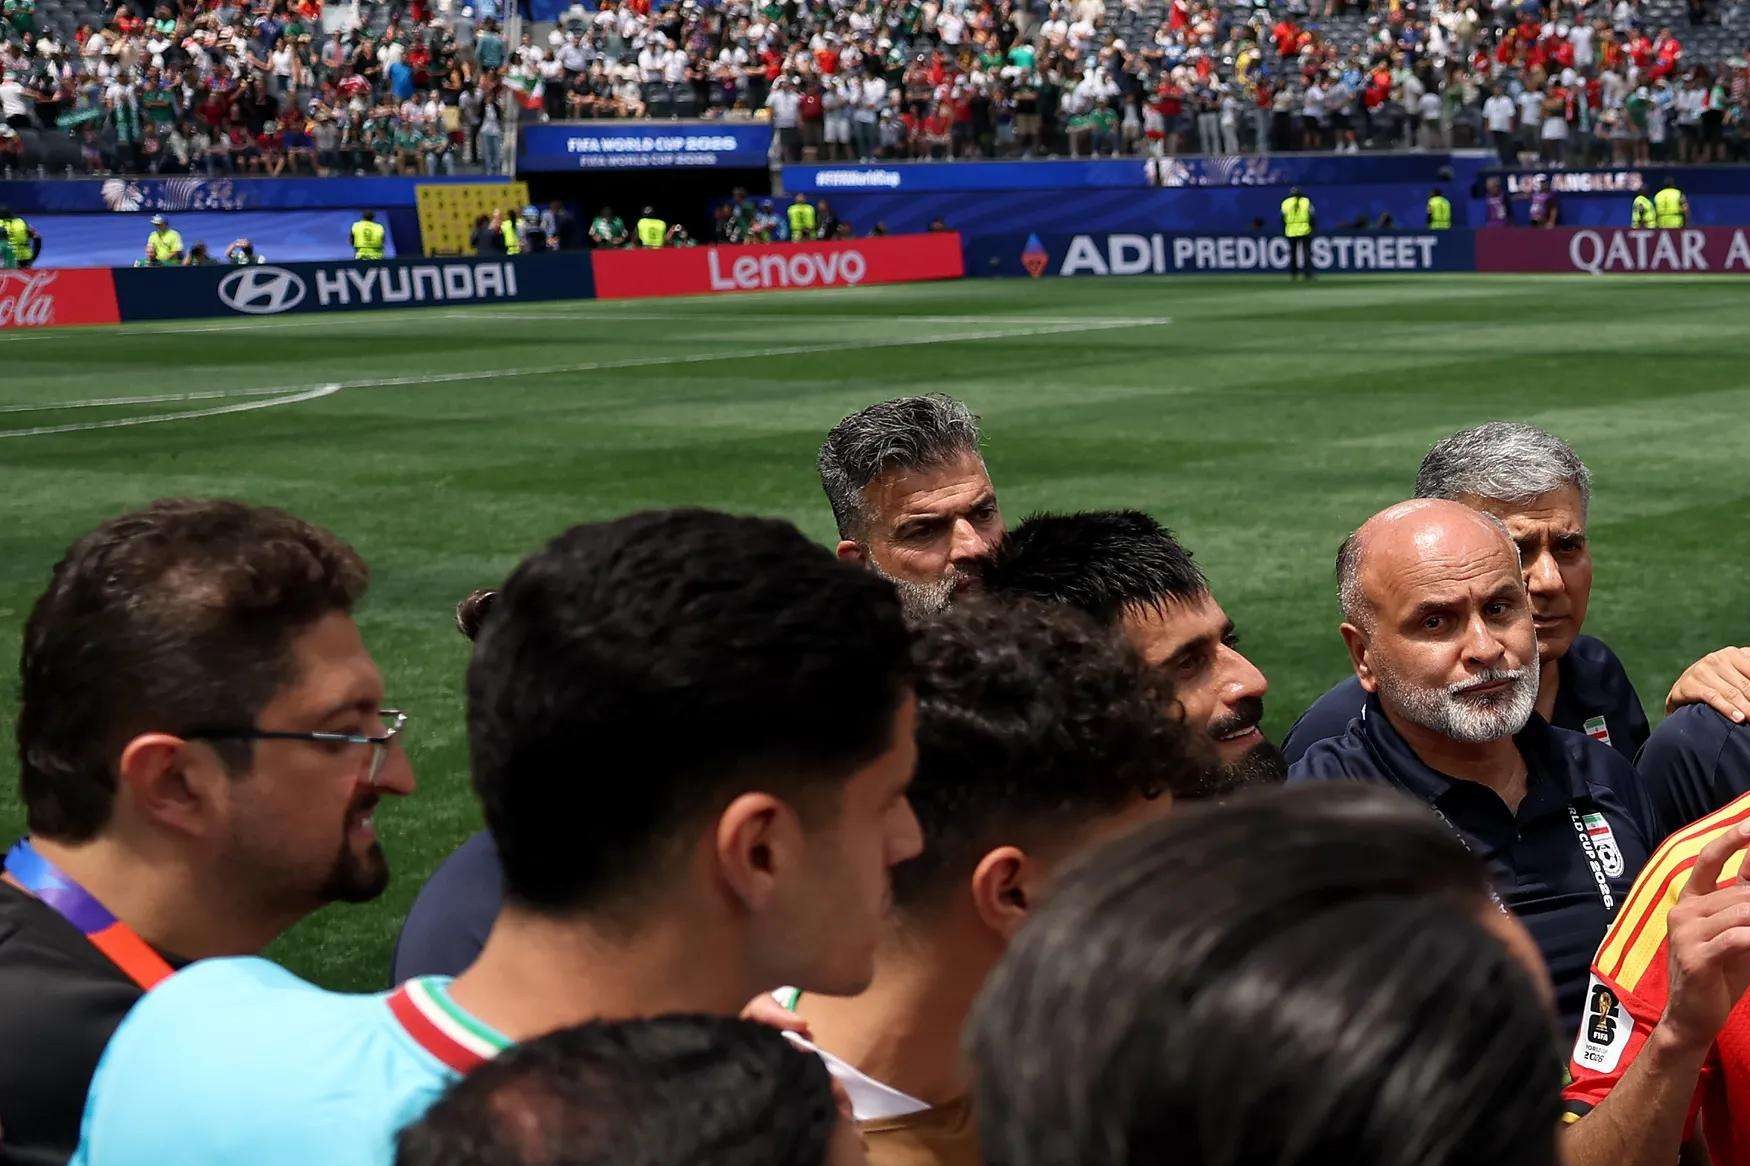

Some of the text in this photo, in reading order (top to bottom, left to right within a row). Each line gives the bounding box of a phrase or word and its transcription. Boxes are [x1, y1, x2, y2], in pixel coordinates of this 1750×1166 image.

[601, 136, 654, 151] WORLD
[655, 136, 684, 151] CUP
[707, 247, 866, 290] Lenovo
[1059, 233, 1163, 275] ADI
[1568, 230, 1709, 275] QATAR
[0, 268, 59, 326] ola
[317, 262, 517, 304] HYUNDAI
[1579, 833, 1597, 860] CUP
